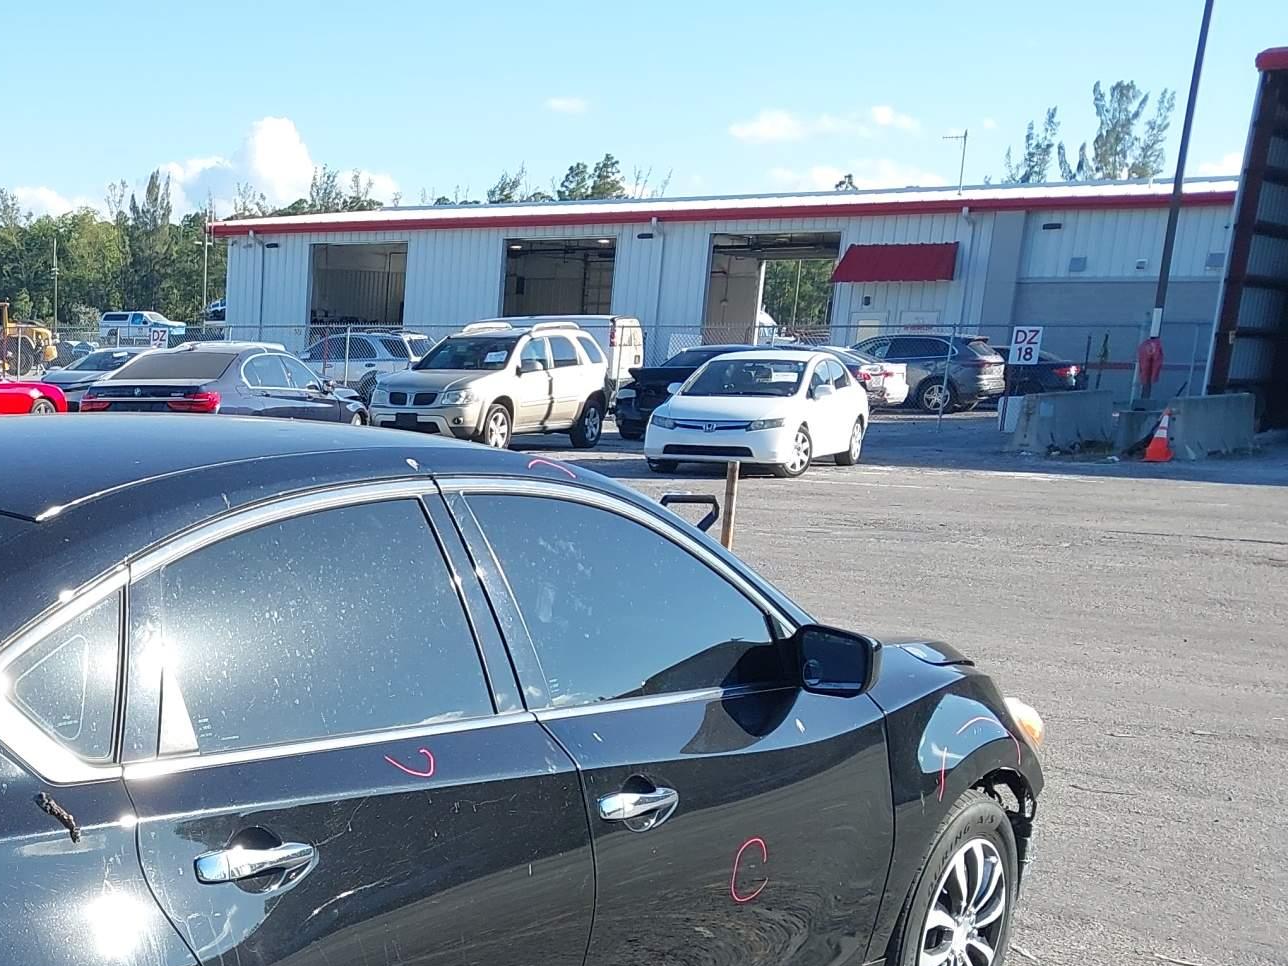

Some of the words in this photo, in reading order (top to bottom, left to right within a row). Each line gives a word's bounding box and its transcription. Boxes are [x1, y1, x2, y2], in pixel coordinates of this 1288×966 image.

[152, 330, 167, 341] DZ
[1014, 329, 1040, 345] DZ
[1017, 347, 1033, 362] 18
